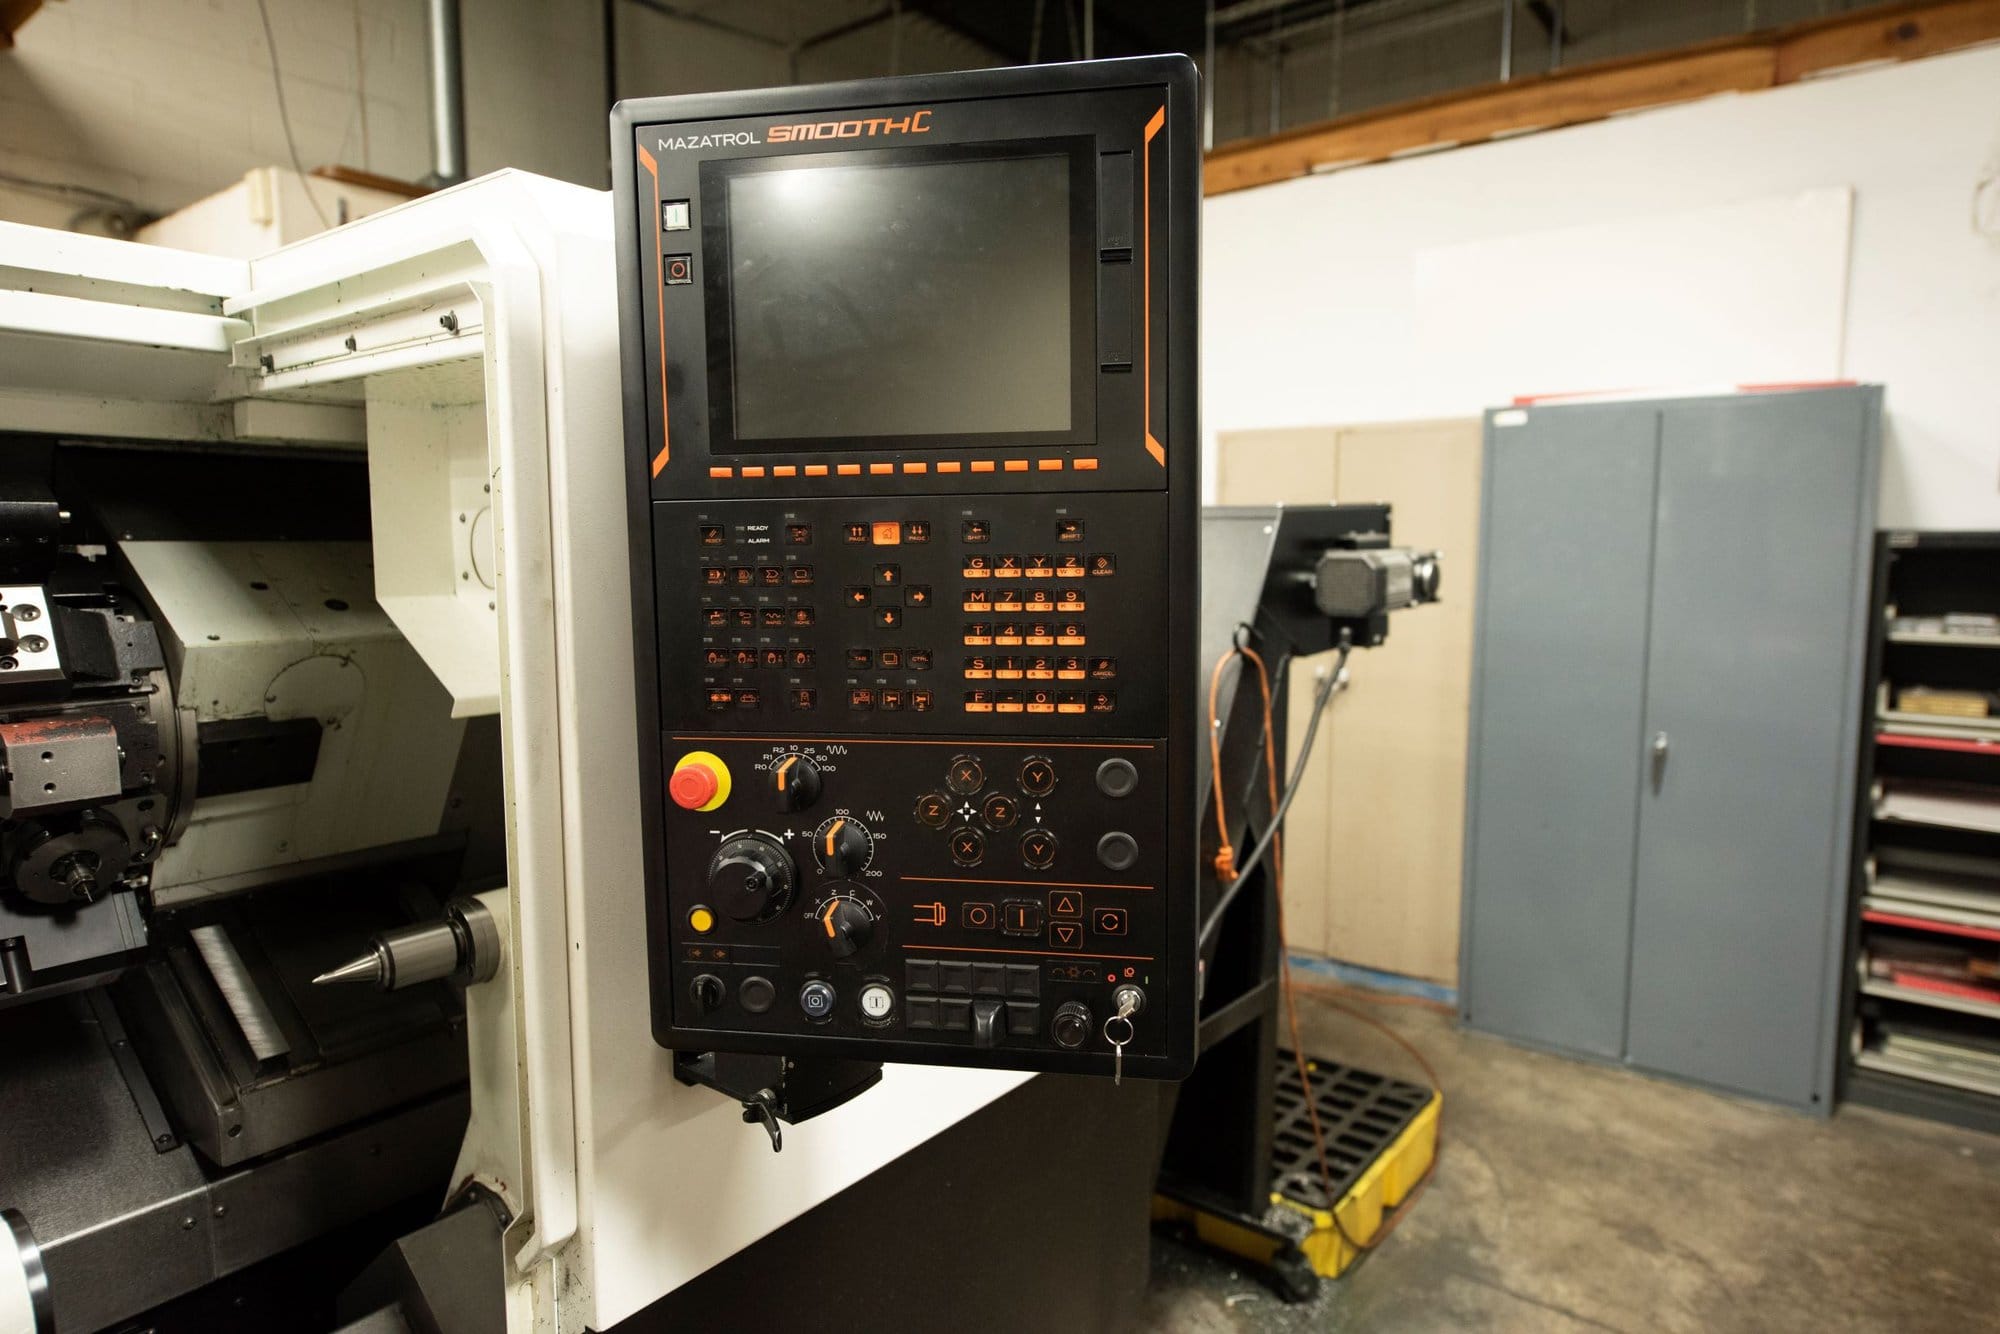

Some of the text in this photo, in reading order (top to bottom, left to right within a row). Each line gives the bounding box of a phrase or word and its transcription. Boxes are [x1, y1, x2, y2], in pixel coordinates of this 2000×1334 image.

[658, 132, 761, 151] MAZATROL
[971, 559, 983, 568] G
[1003, 558, 1014, 567] X
[1034, 558, 1044, 567] Y
[1065, 557, 1076, 567] Z
[971, 592, 984, 601] M
[1003, 592, 1013, 601] 7
[1035, 592, 1045, 601] 8
[1066, 592, 1076, 601] 9
[973, 626, 983, 635] T
[1004, 626, 1015, 635] 4
[1035, 626, 1045, 635] 5
[1066, 626, 1077, 635] 6
[973, 660, 984, 669] S
[1008, 660, 1012, 669] 1
[1035, 660, 1045, 669] 2
[1067, 660, 1077, 669] 3
[975, 693, 984, 701] F
[962, 770, 971, 781] X
[1033, 772, 1043, 782] Y
[929, 805, 938, 815] Z
[996, 808, 1005, 817] Z
[962, 842, 972, 853] X
[1033, 844, 1043, 855] Y
